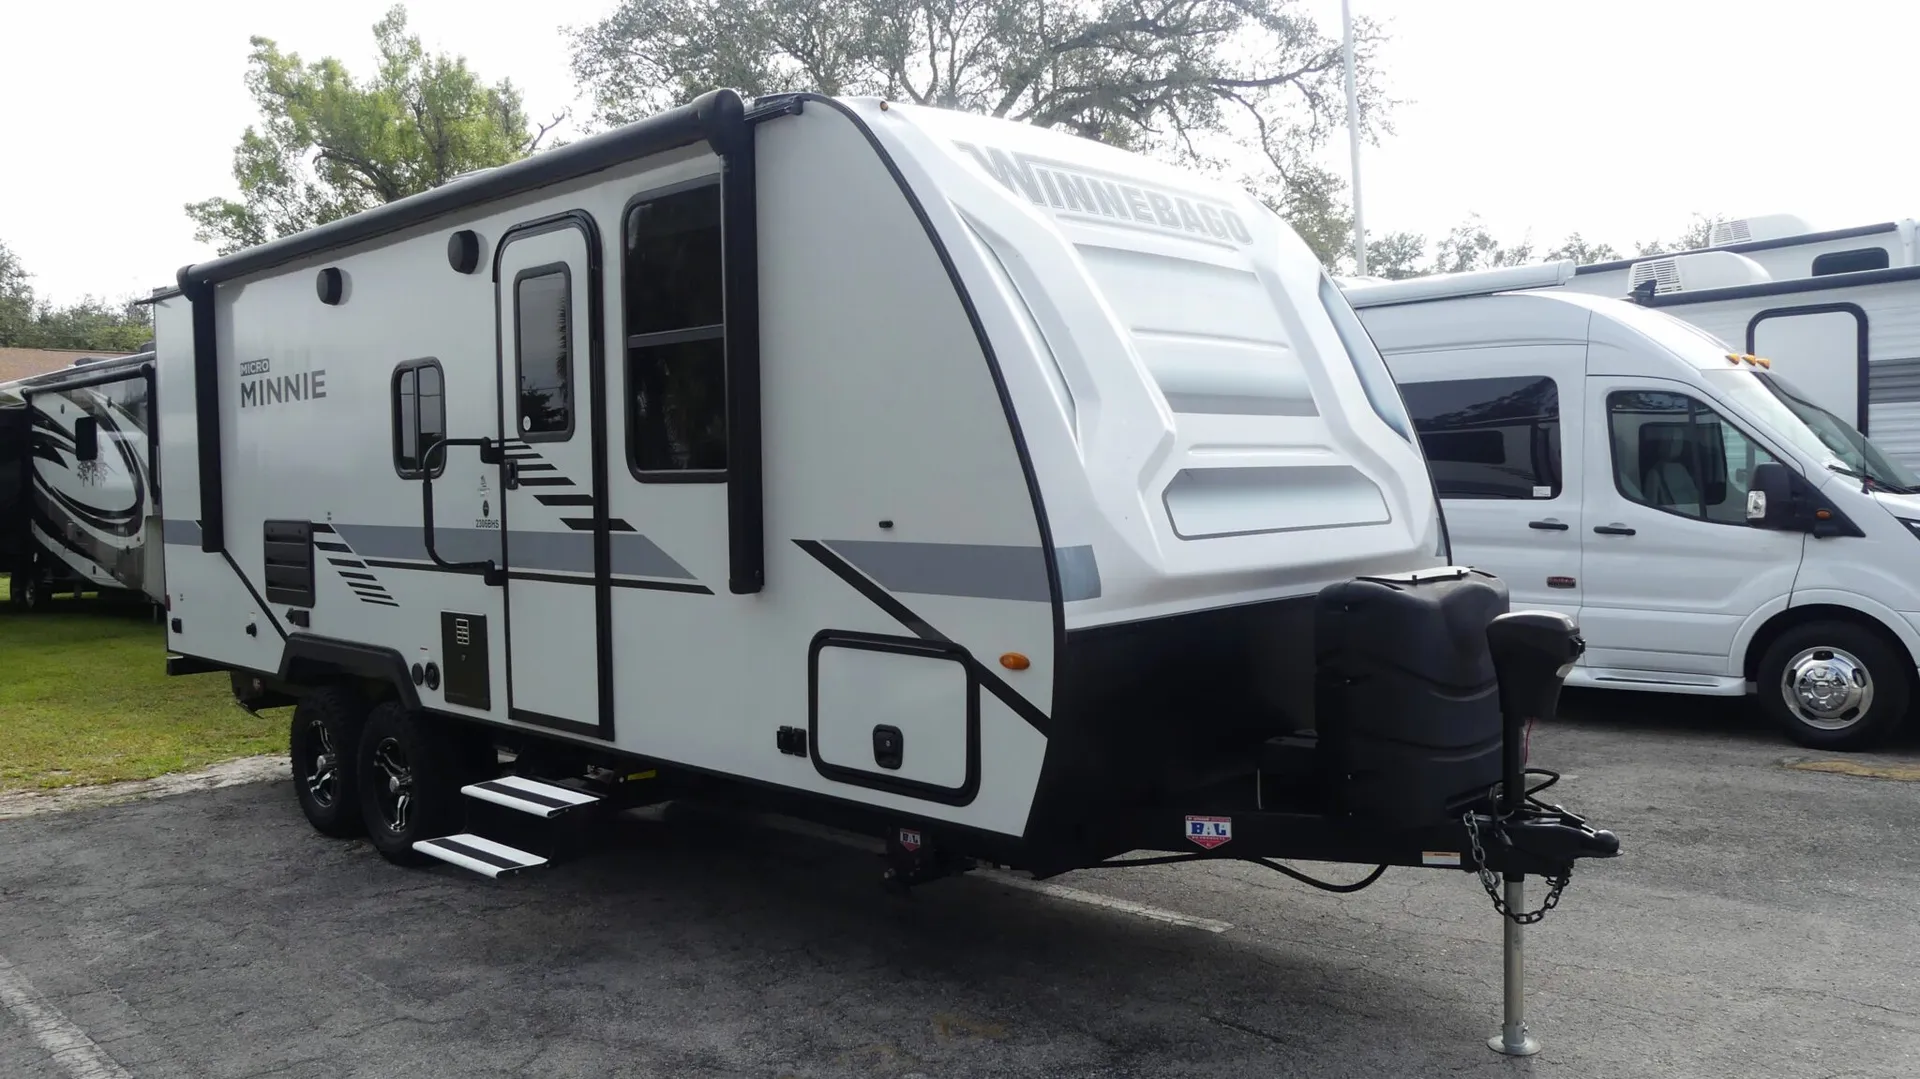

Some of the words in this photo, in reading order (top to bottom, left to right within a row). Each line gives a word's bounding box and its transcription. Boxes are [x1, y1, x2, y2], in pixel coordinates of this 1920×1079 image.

[952, 140, 1253, 245] WINNEBAGO
[241, 360, 269, 375] MICRO
[241, 370, 326, 408] MINNIE
